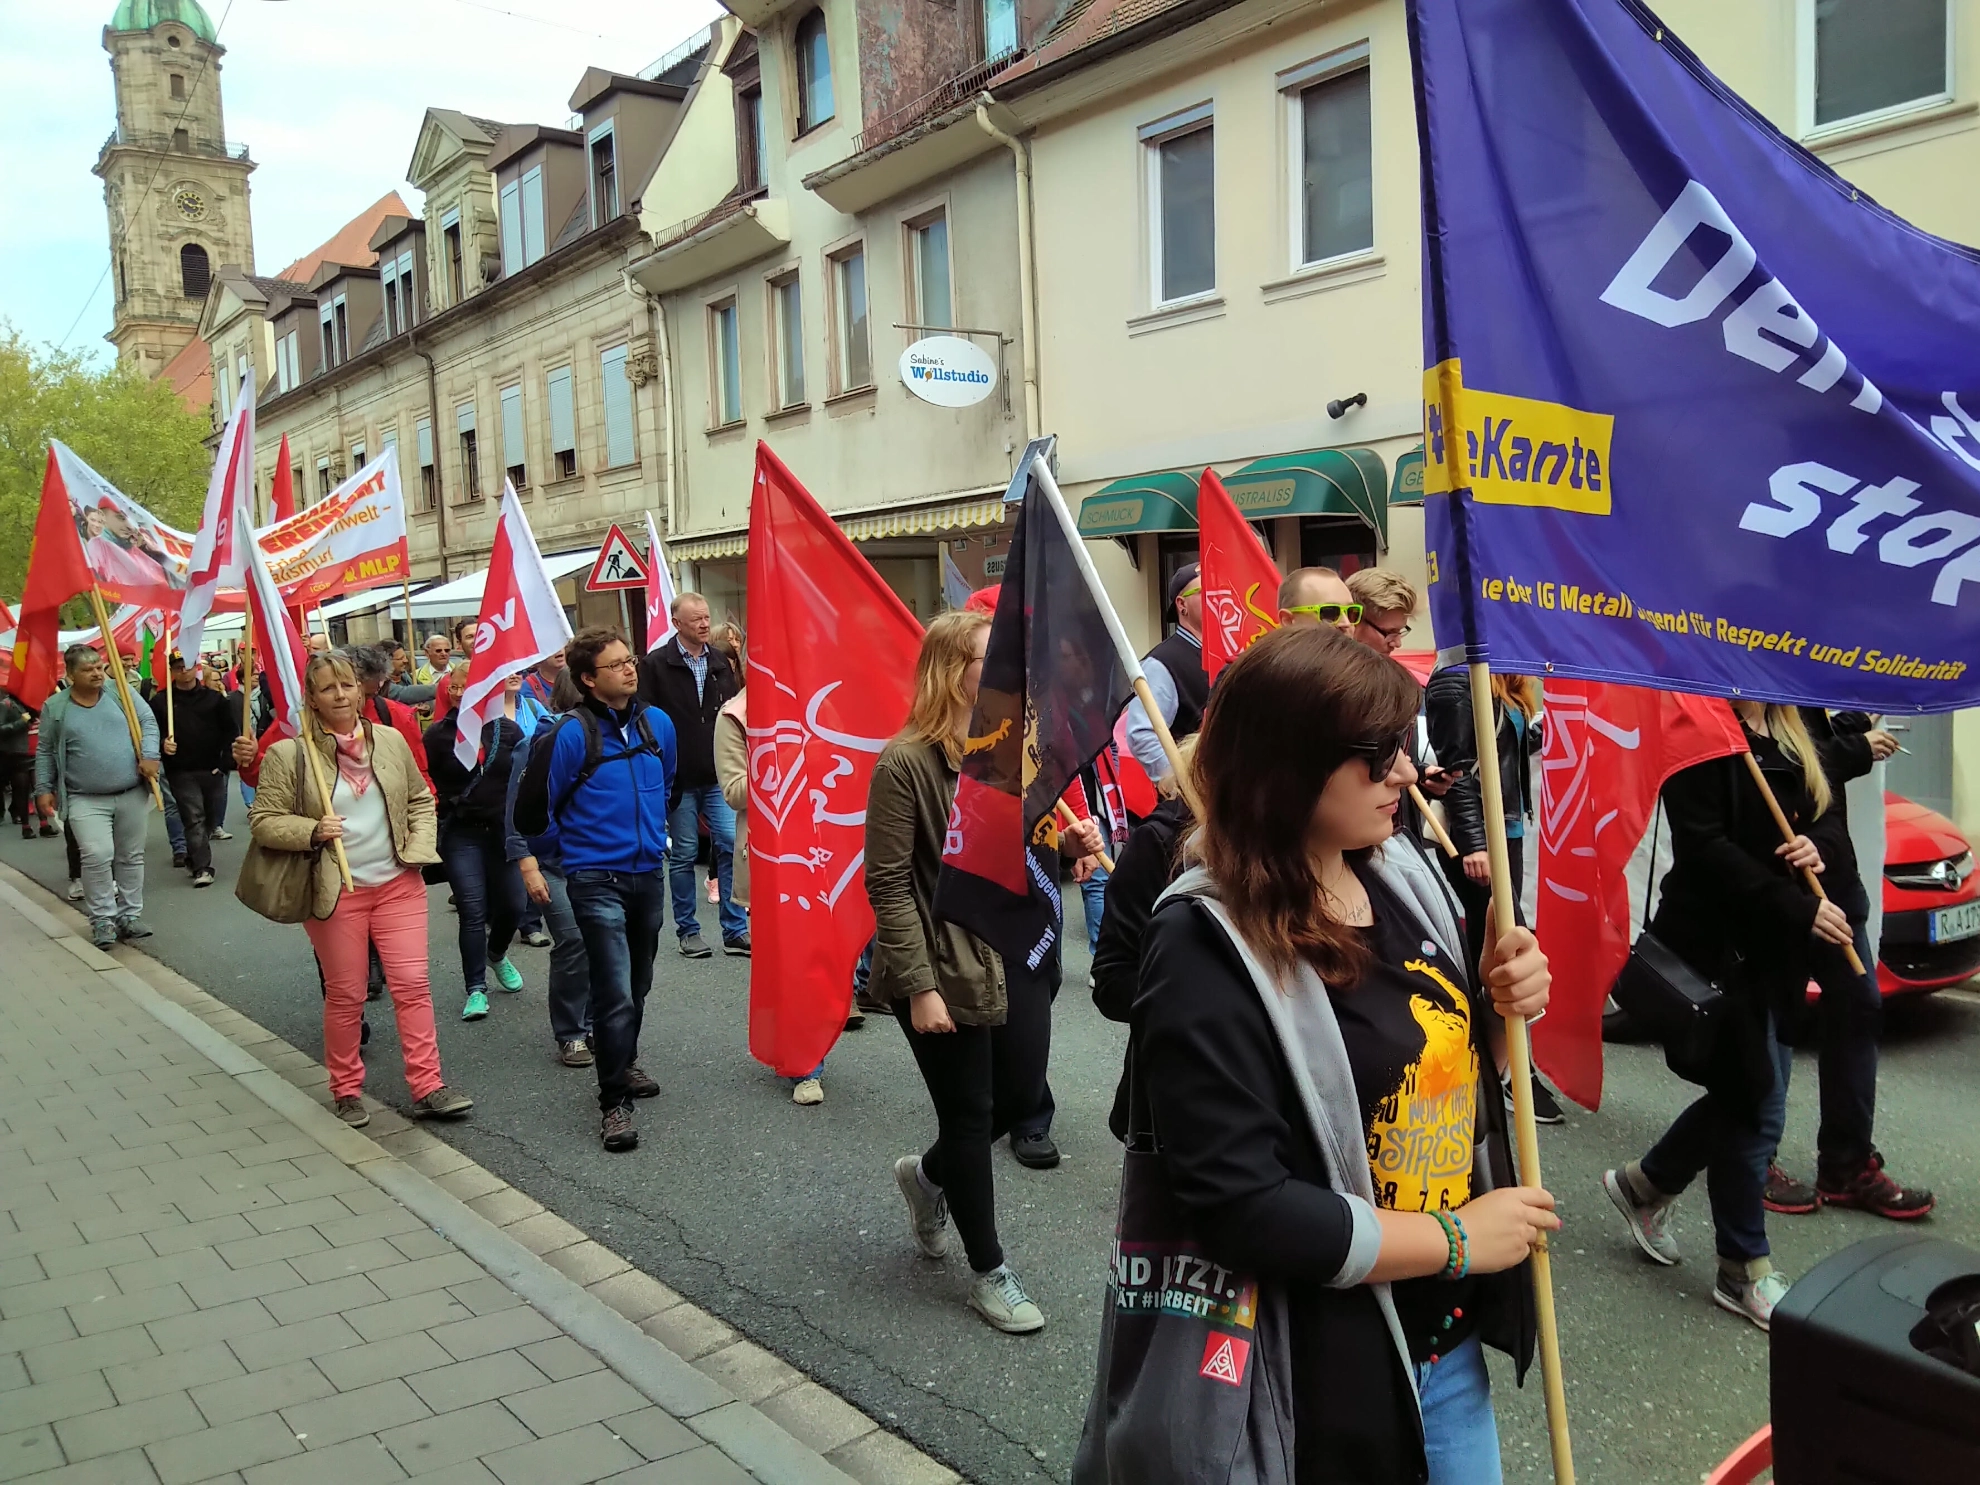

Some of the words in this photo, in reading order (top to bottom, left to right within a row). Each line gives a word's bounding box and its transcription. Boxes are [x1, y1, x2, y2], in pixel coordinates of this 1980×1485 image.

[910, 365, 989, 384] Wollstudio
[1086, 507, 1134, 525] SCHMUCK
[359, 553, 402, 578] MLP
[1507, 575, 1532, 605] der
[1537, 581, 1555, 610] IG
[1560, 584, 1632, 619] Metall
[1690, 611, 1711, 638] für
[1717, 617, 1807, 656] Respekt
[1810, 645, 1861, 668] und
[1859, 650, 1967, 681] Solidarität
